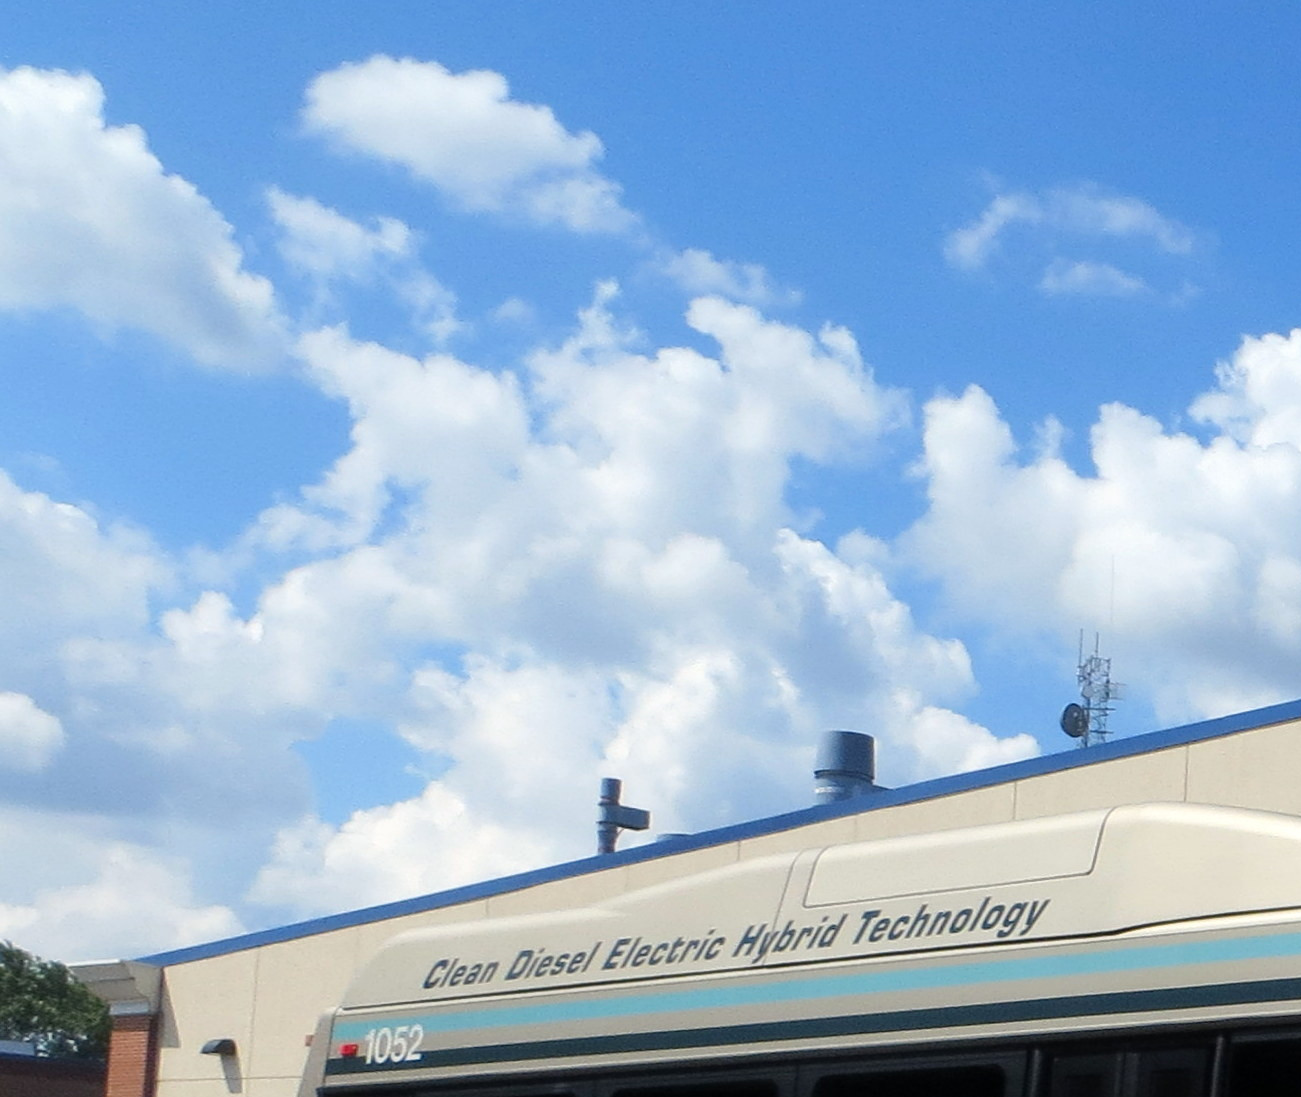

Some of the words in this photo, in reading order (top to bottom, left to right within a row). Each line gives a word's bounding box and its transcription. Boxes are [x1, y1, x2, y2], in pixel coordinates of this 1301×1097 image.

[422, 958, 499, 990] Clean
[505, 941, 602, 982] Diesel
[603, 927, 727, 969] Electric
[733, 912, 842, 966] Hybrid
[852, 898, 1051, 943] Technology
[364, 1024, 423, 1065] 1052
